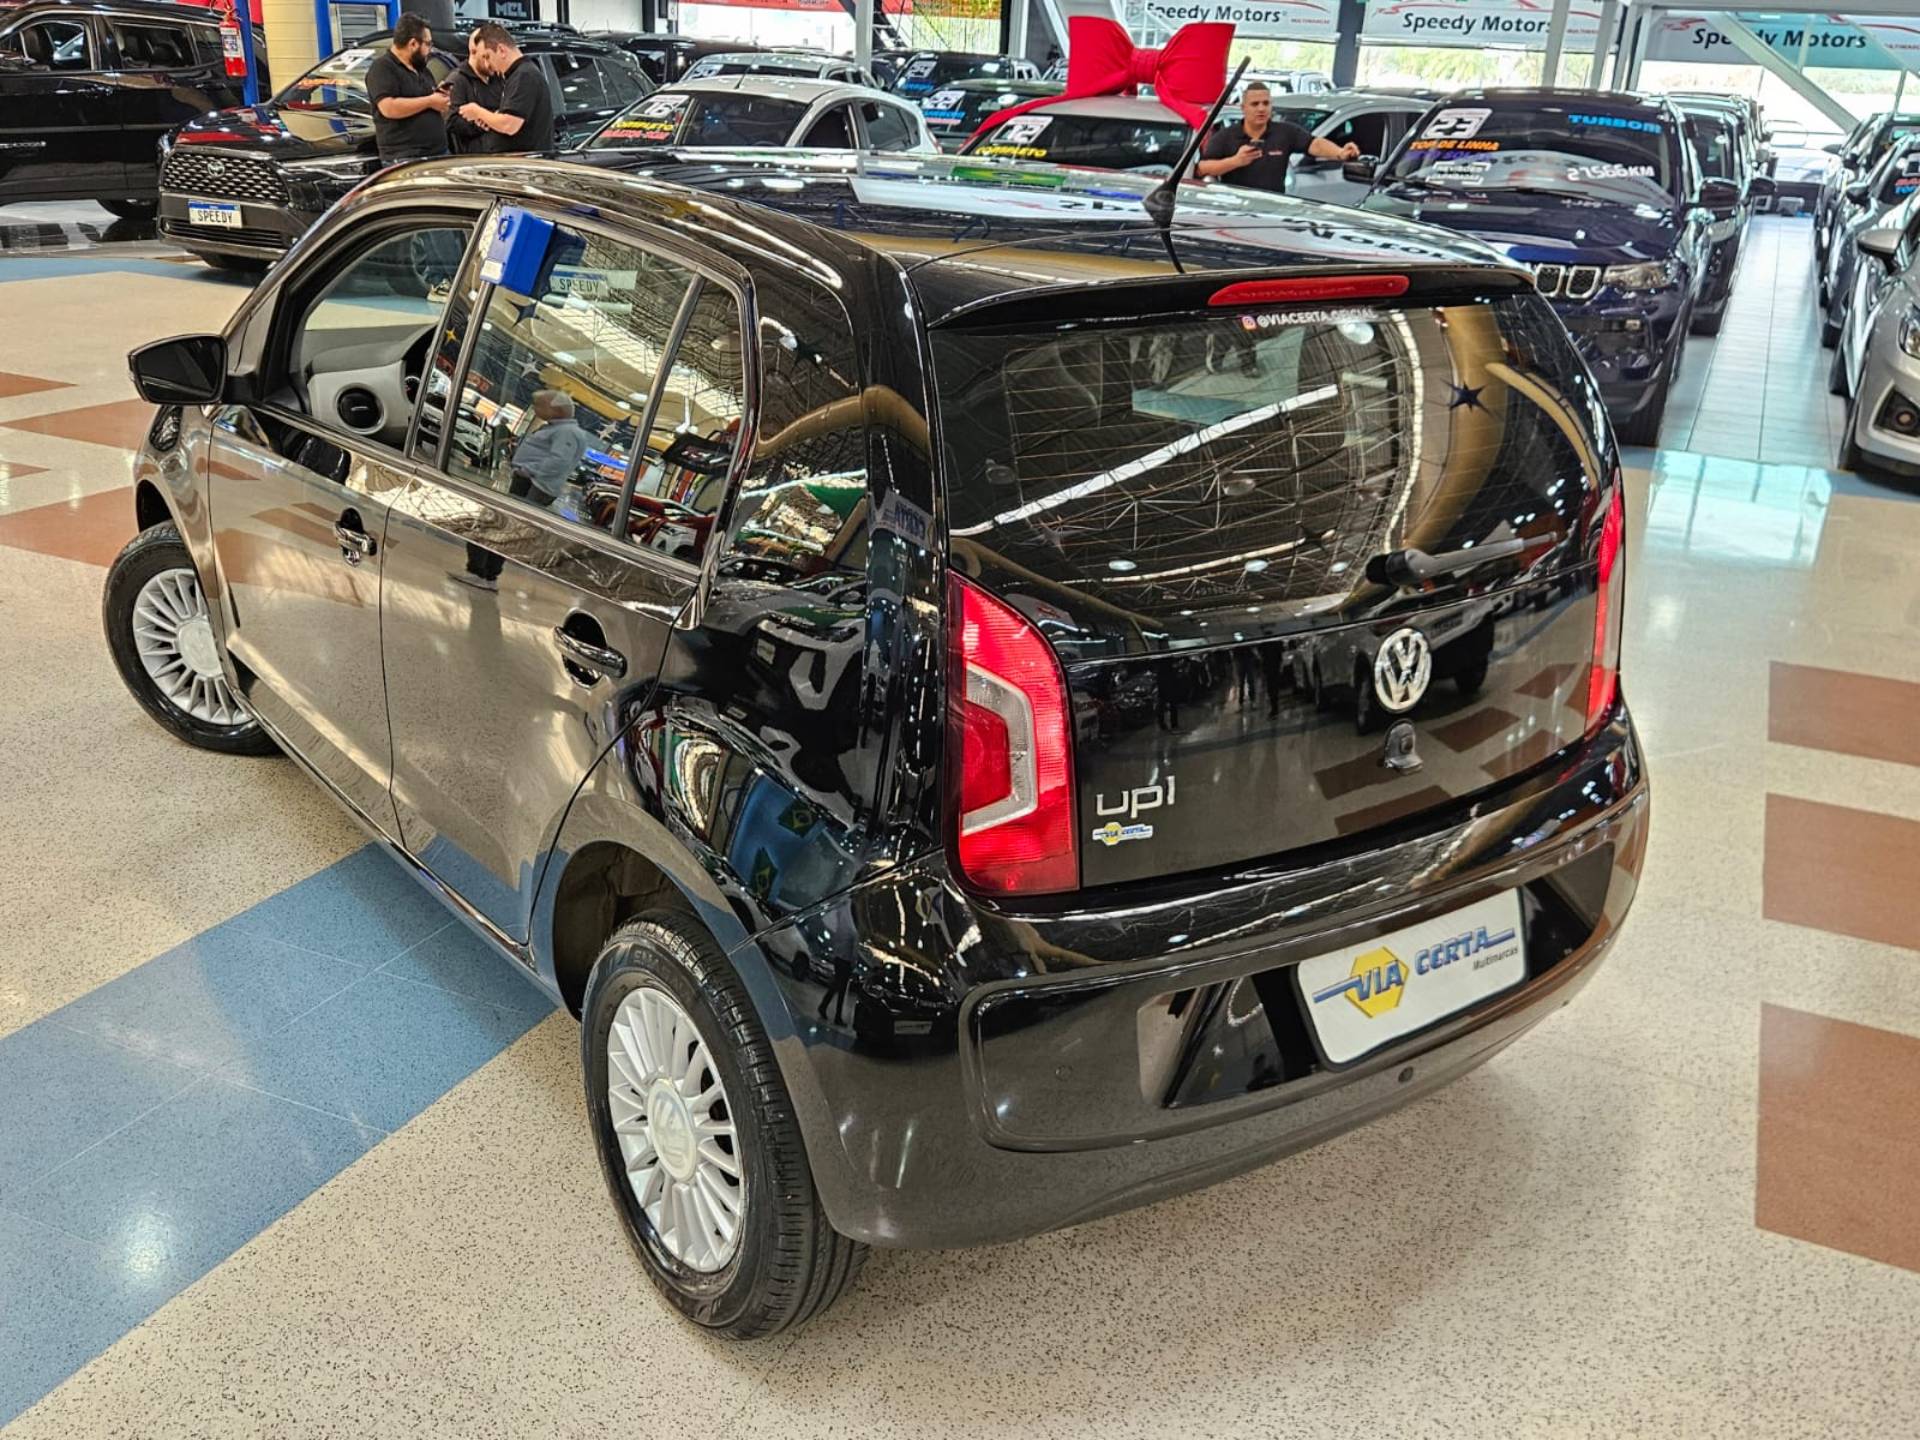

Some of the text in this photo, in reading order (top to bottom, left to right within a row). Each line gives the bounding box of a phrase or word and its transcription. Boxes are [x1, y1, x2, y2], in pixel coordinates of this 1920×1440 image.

[1215, 5, 1280, 22] Motors
[1402, 12, 1477, 35] Speedy
[1783, 30, 1866, 48] Motors
[197, 209, 233, 223] SPEEDY
[559, 278, 600, 291] SPEEDY
[1472, 946, 1519, 971] Multimarcas
[1352, 959, 1404, 1002] VIA
